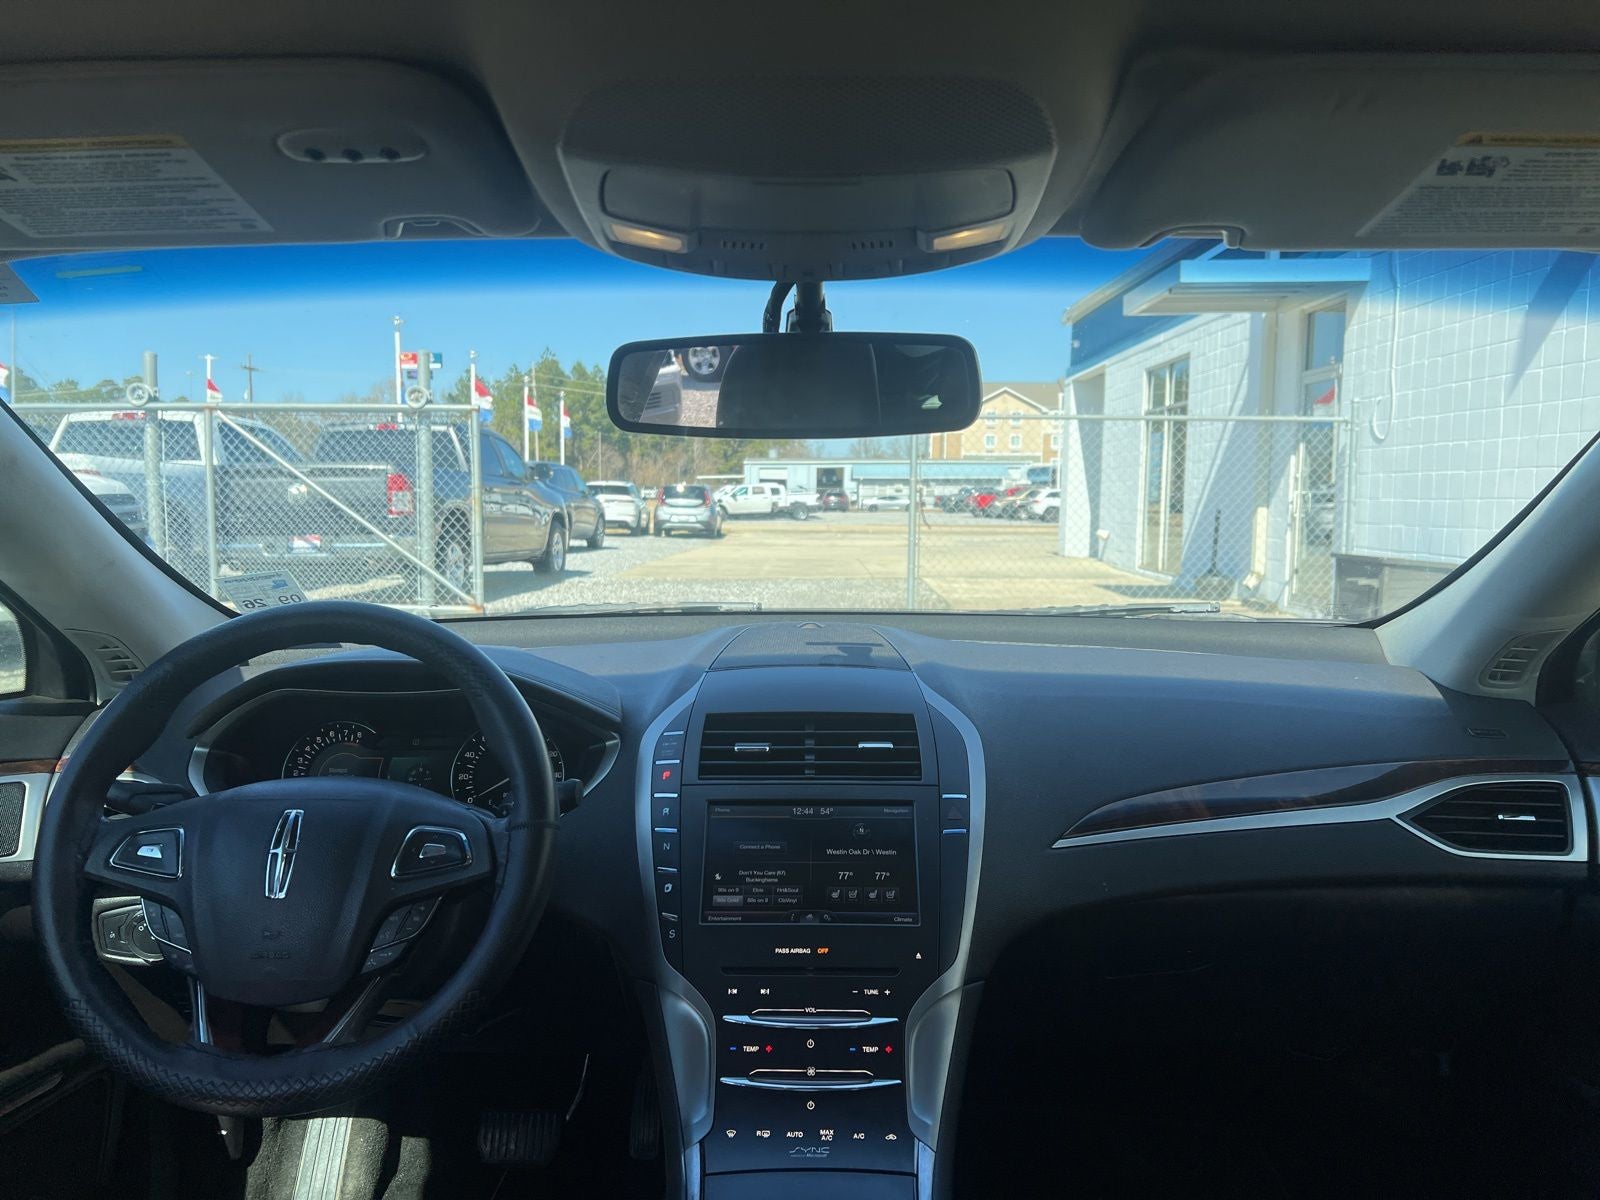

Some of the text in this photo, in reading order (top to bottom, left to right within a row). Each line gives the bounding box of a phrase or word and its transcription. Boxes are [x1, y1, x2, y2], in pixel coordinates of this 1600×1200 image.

[662, 807, 670, 816] R
[792, 807, 814, 815] 12:44
[663, 842, 671, 851] N
[669, 929, 676, 939] S
